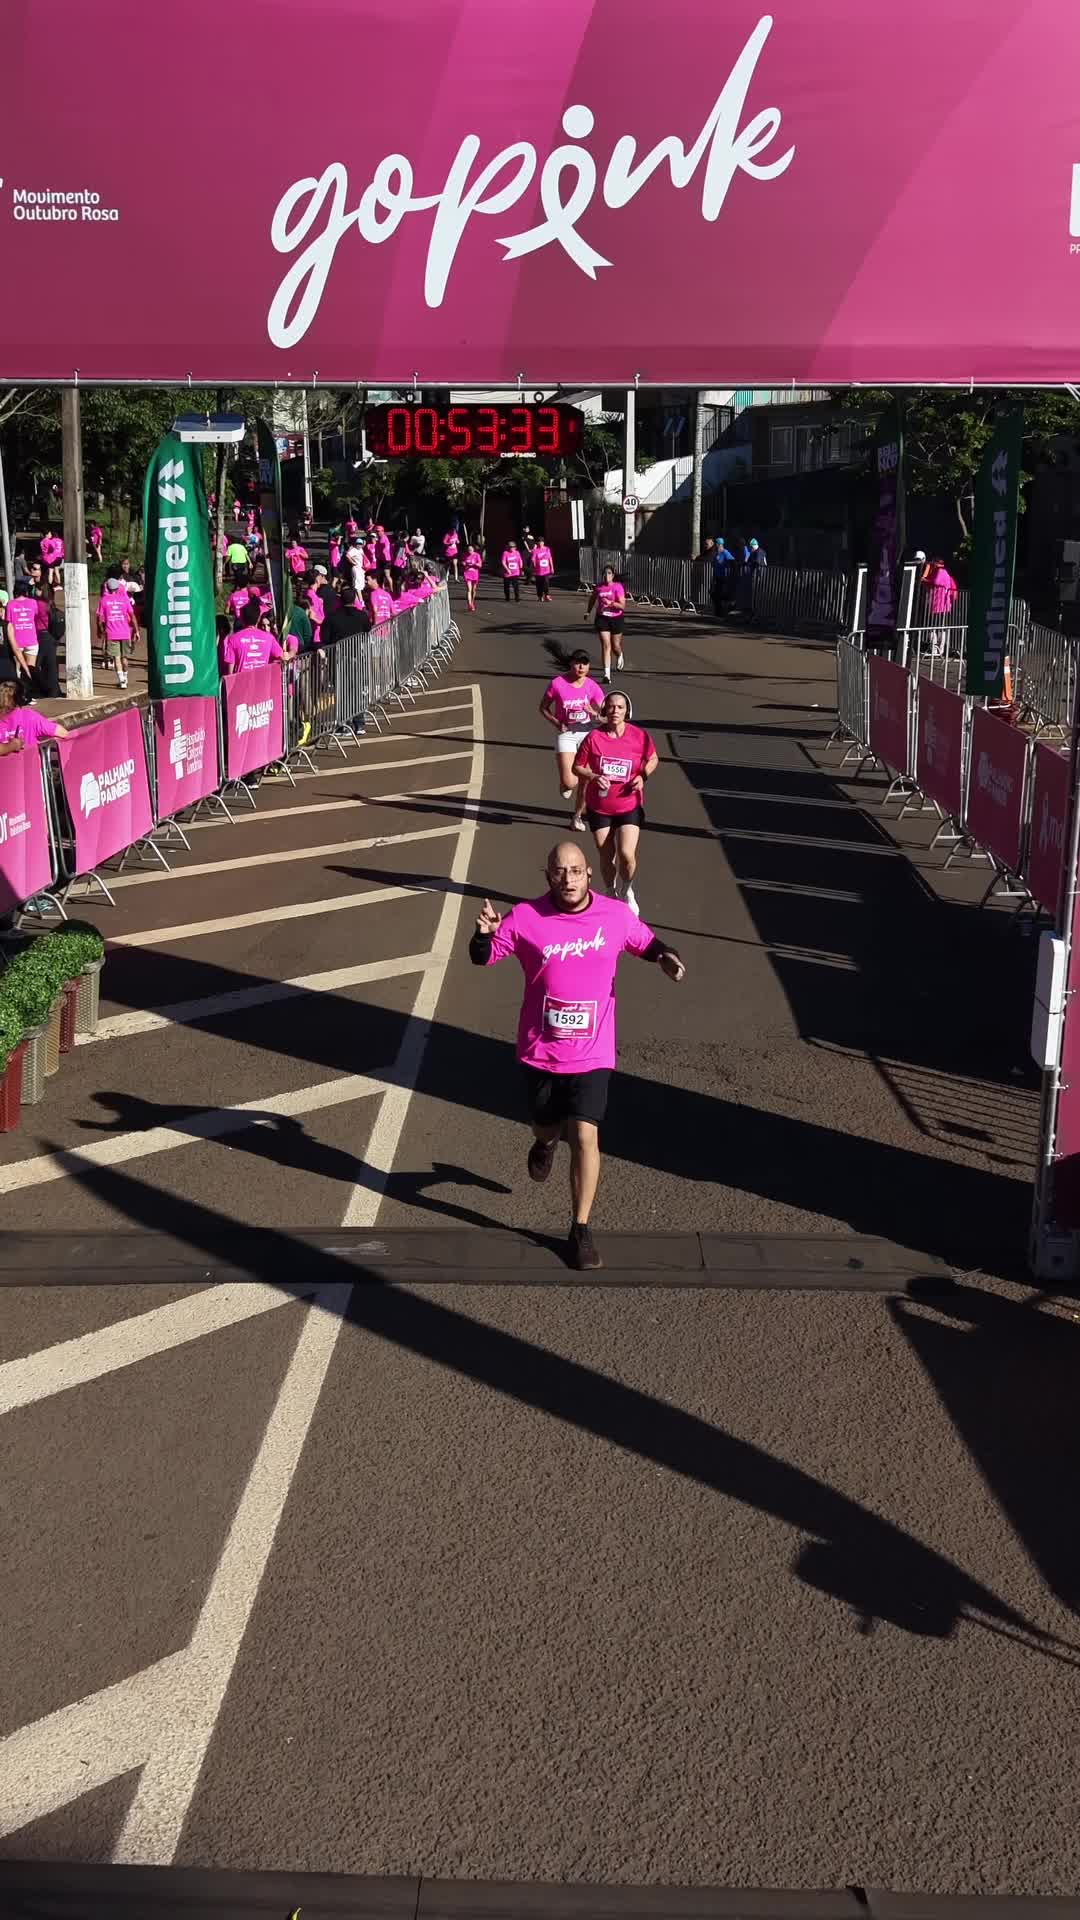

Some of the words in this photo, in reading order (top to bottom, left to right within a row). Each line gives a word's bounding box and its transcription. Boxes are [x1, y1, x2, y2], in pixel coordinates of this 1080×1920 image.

[13, 188, 100, 204] Movimento
[13, 205, 78, 220] Outubro
[81, 206, 119, 220] Rosa
[387, 408, 559, 450] 00:53:33
[624, 498, 636, 506] 40
[158, 516, 195, 684] Unimed
[98, 758, 135, 790] PALHANO
[554, 1013, 584, 1025] 1592
